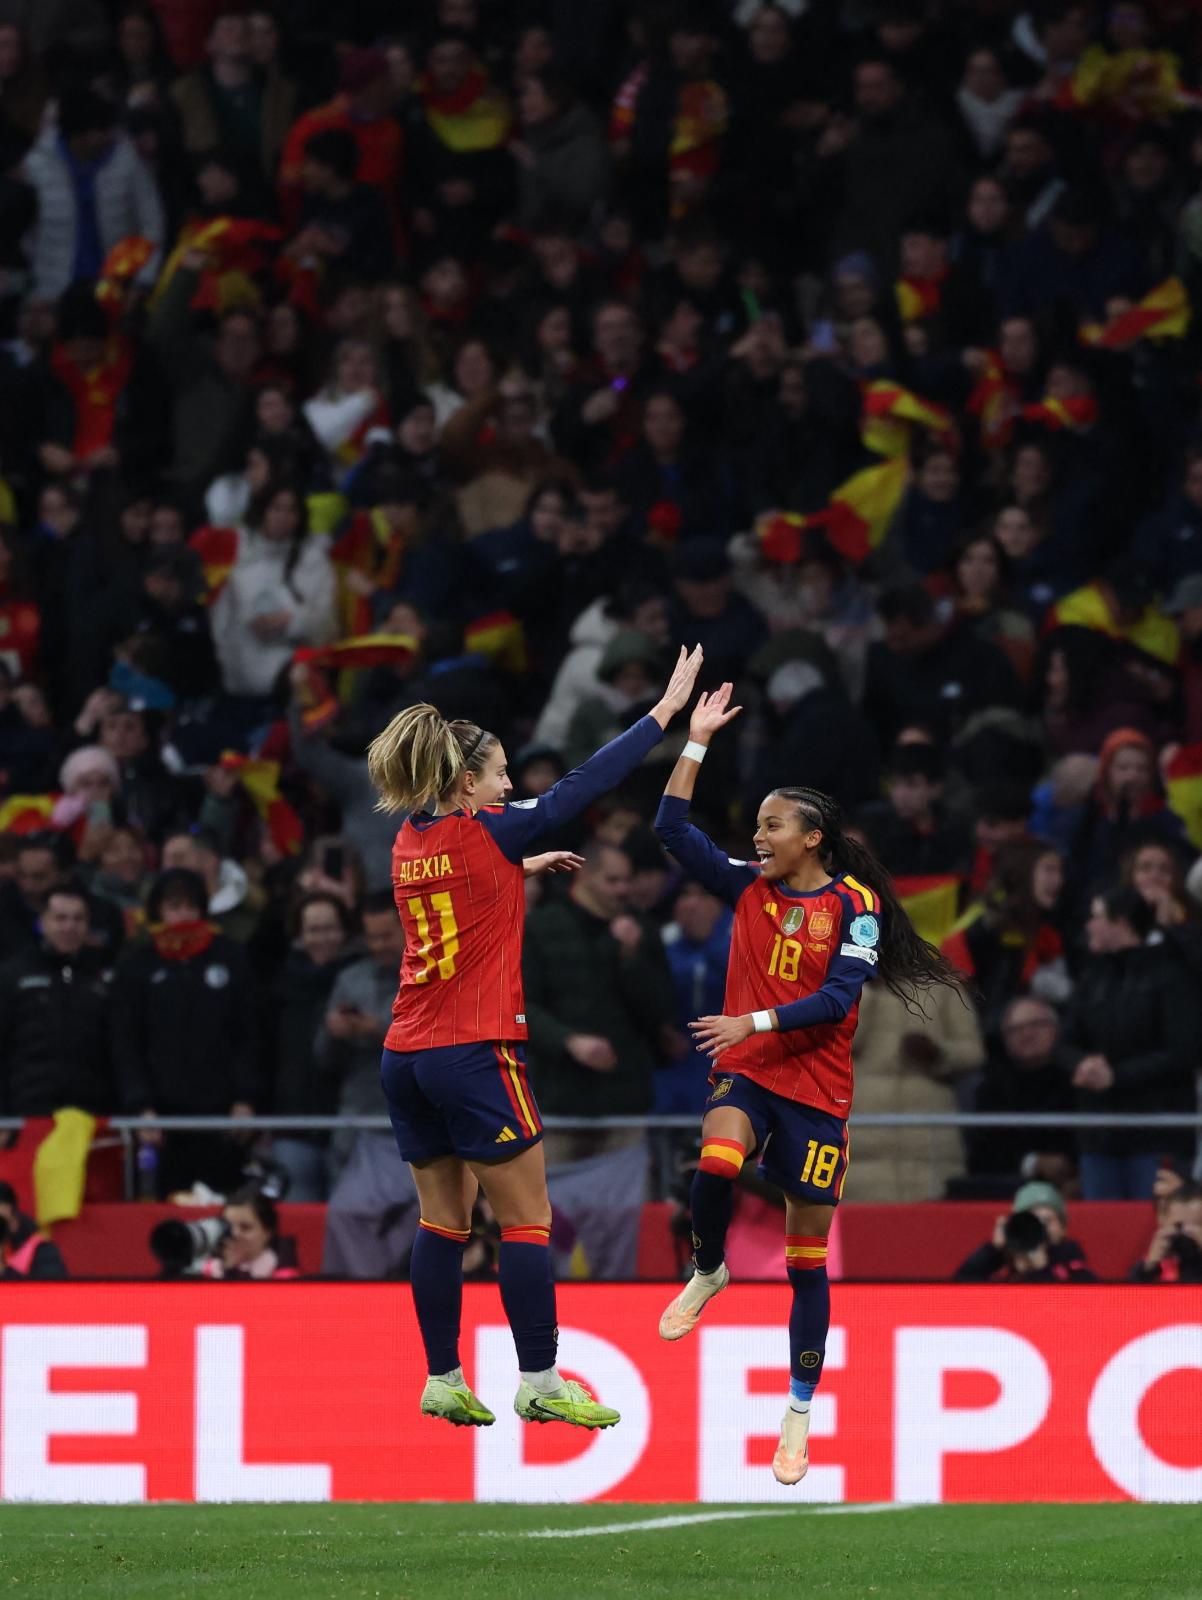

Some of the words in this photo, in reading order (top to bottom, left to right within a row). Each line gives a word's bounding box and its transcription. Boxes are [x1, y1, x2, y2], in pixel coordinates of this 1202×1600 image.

[399, 854, 453, 883] ALEXIA
[407, 891, 460, 984] 11
[768, 933, 803, 982] 18
[800, 1140, 840, 1189] 18
[2, 1324, 333, 1503] EL
